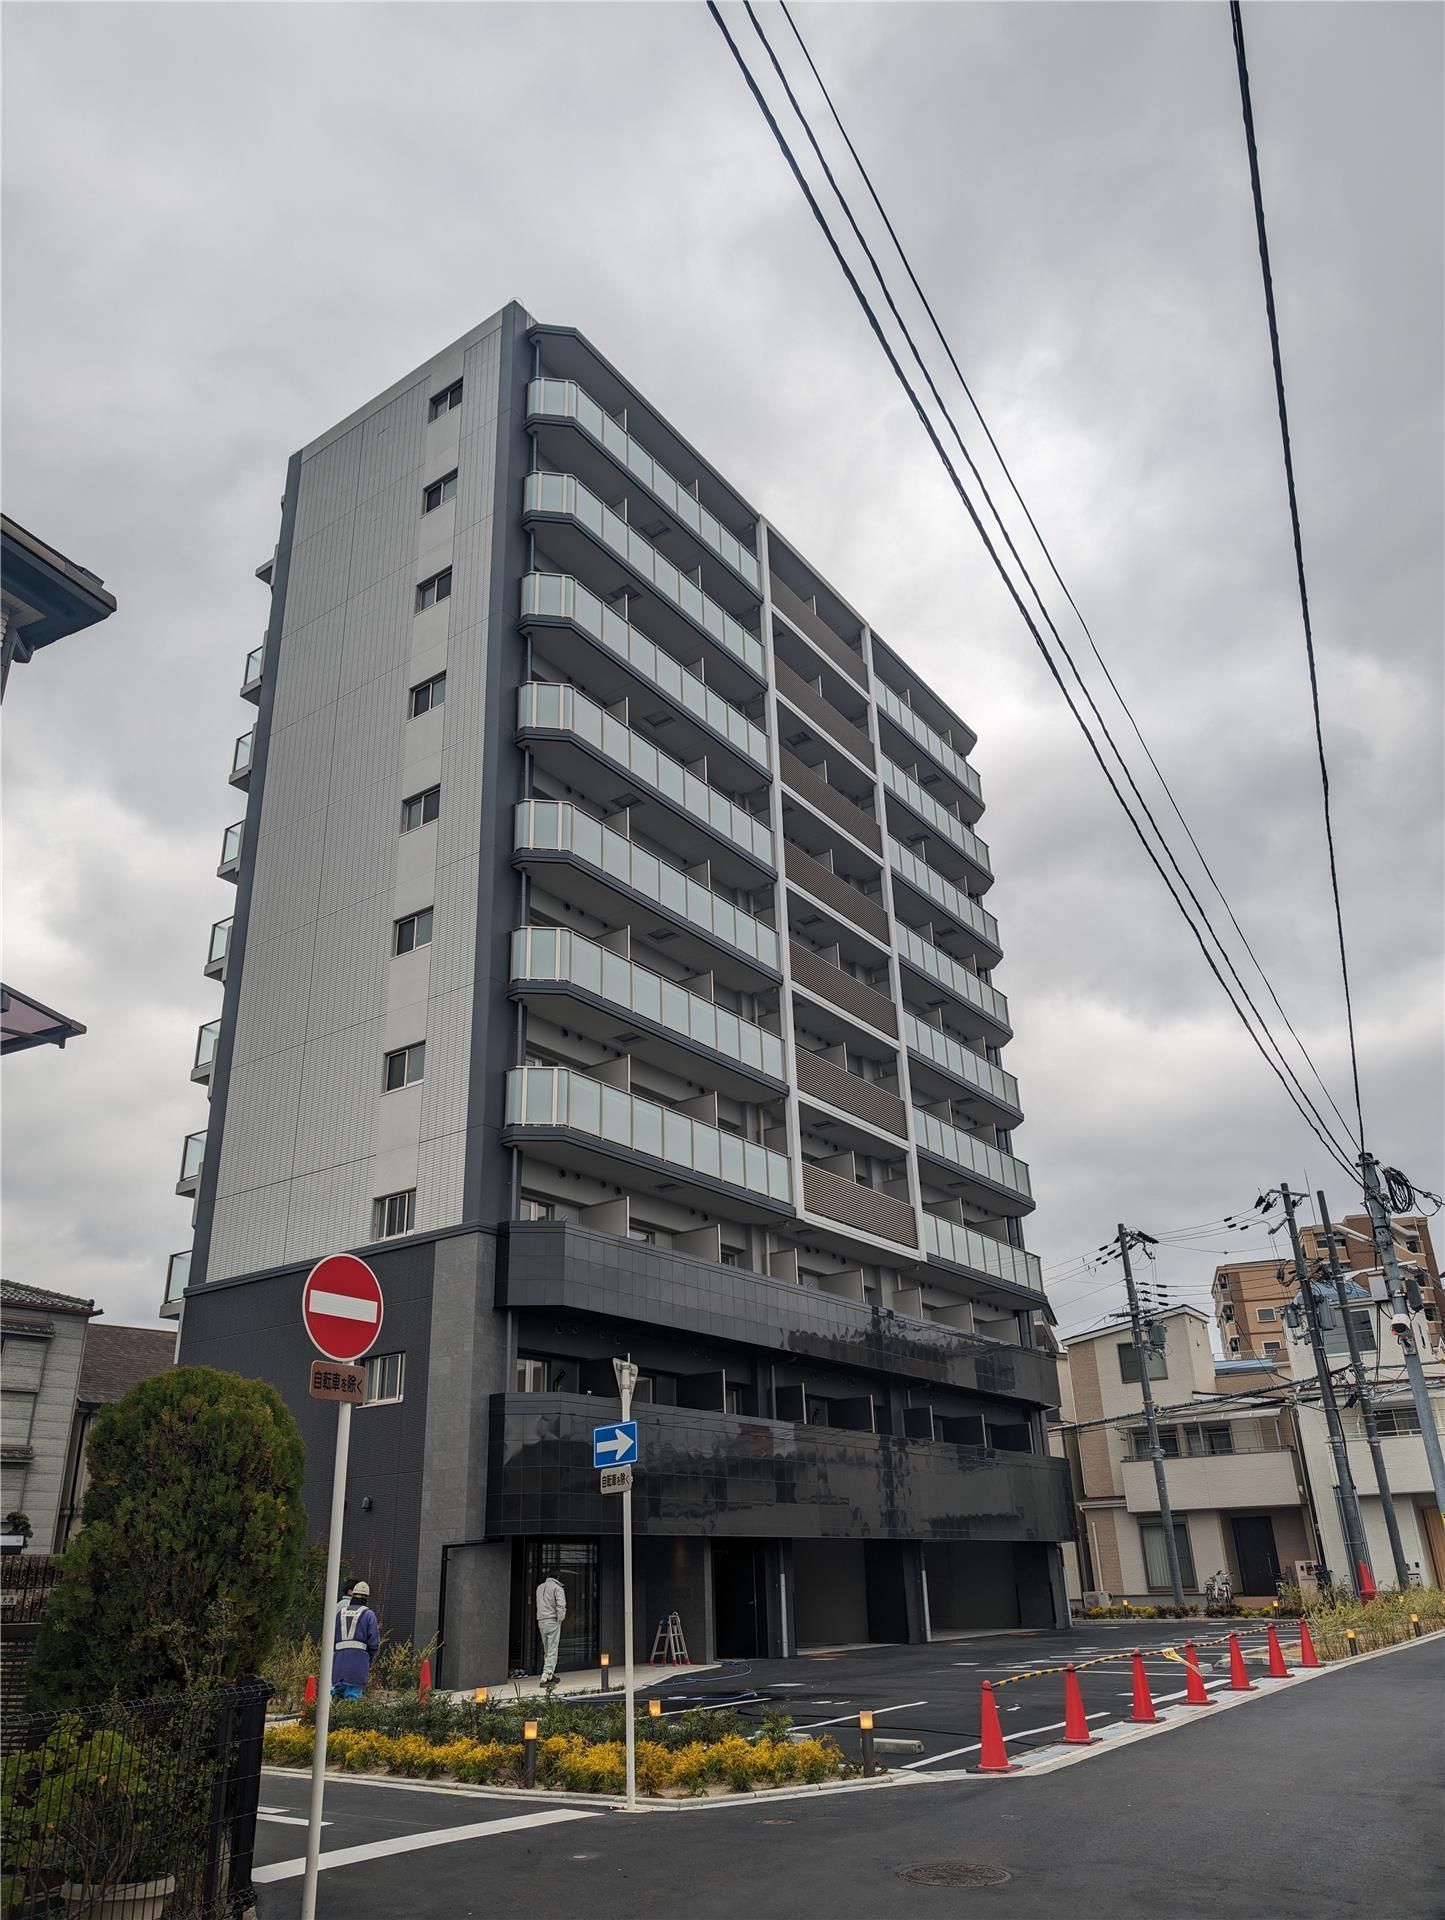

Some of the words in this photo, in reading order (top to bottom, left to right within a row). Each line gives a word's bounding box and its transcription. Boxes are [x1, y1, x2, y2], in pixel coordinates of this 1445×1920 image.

[313, 1371, 363, 1394] 自転車を除く
